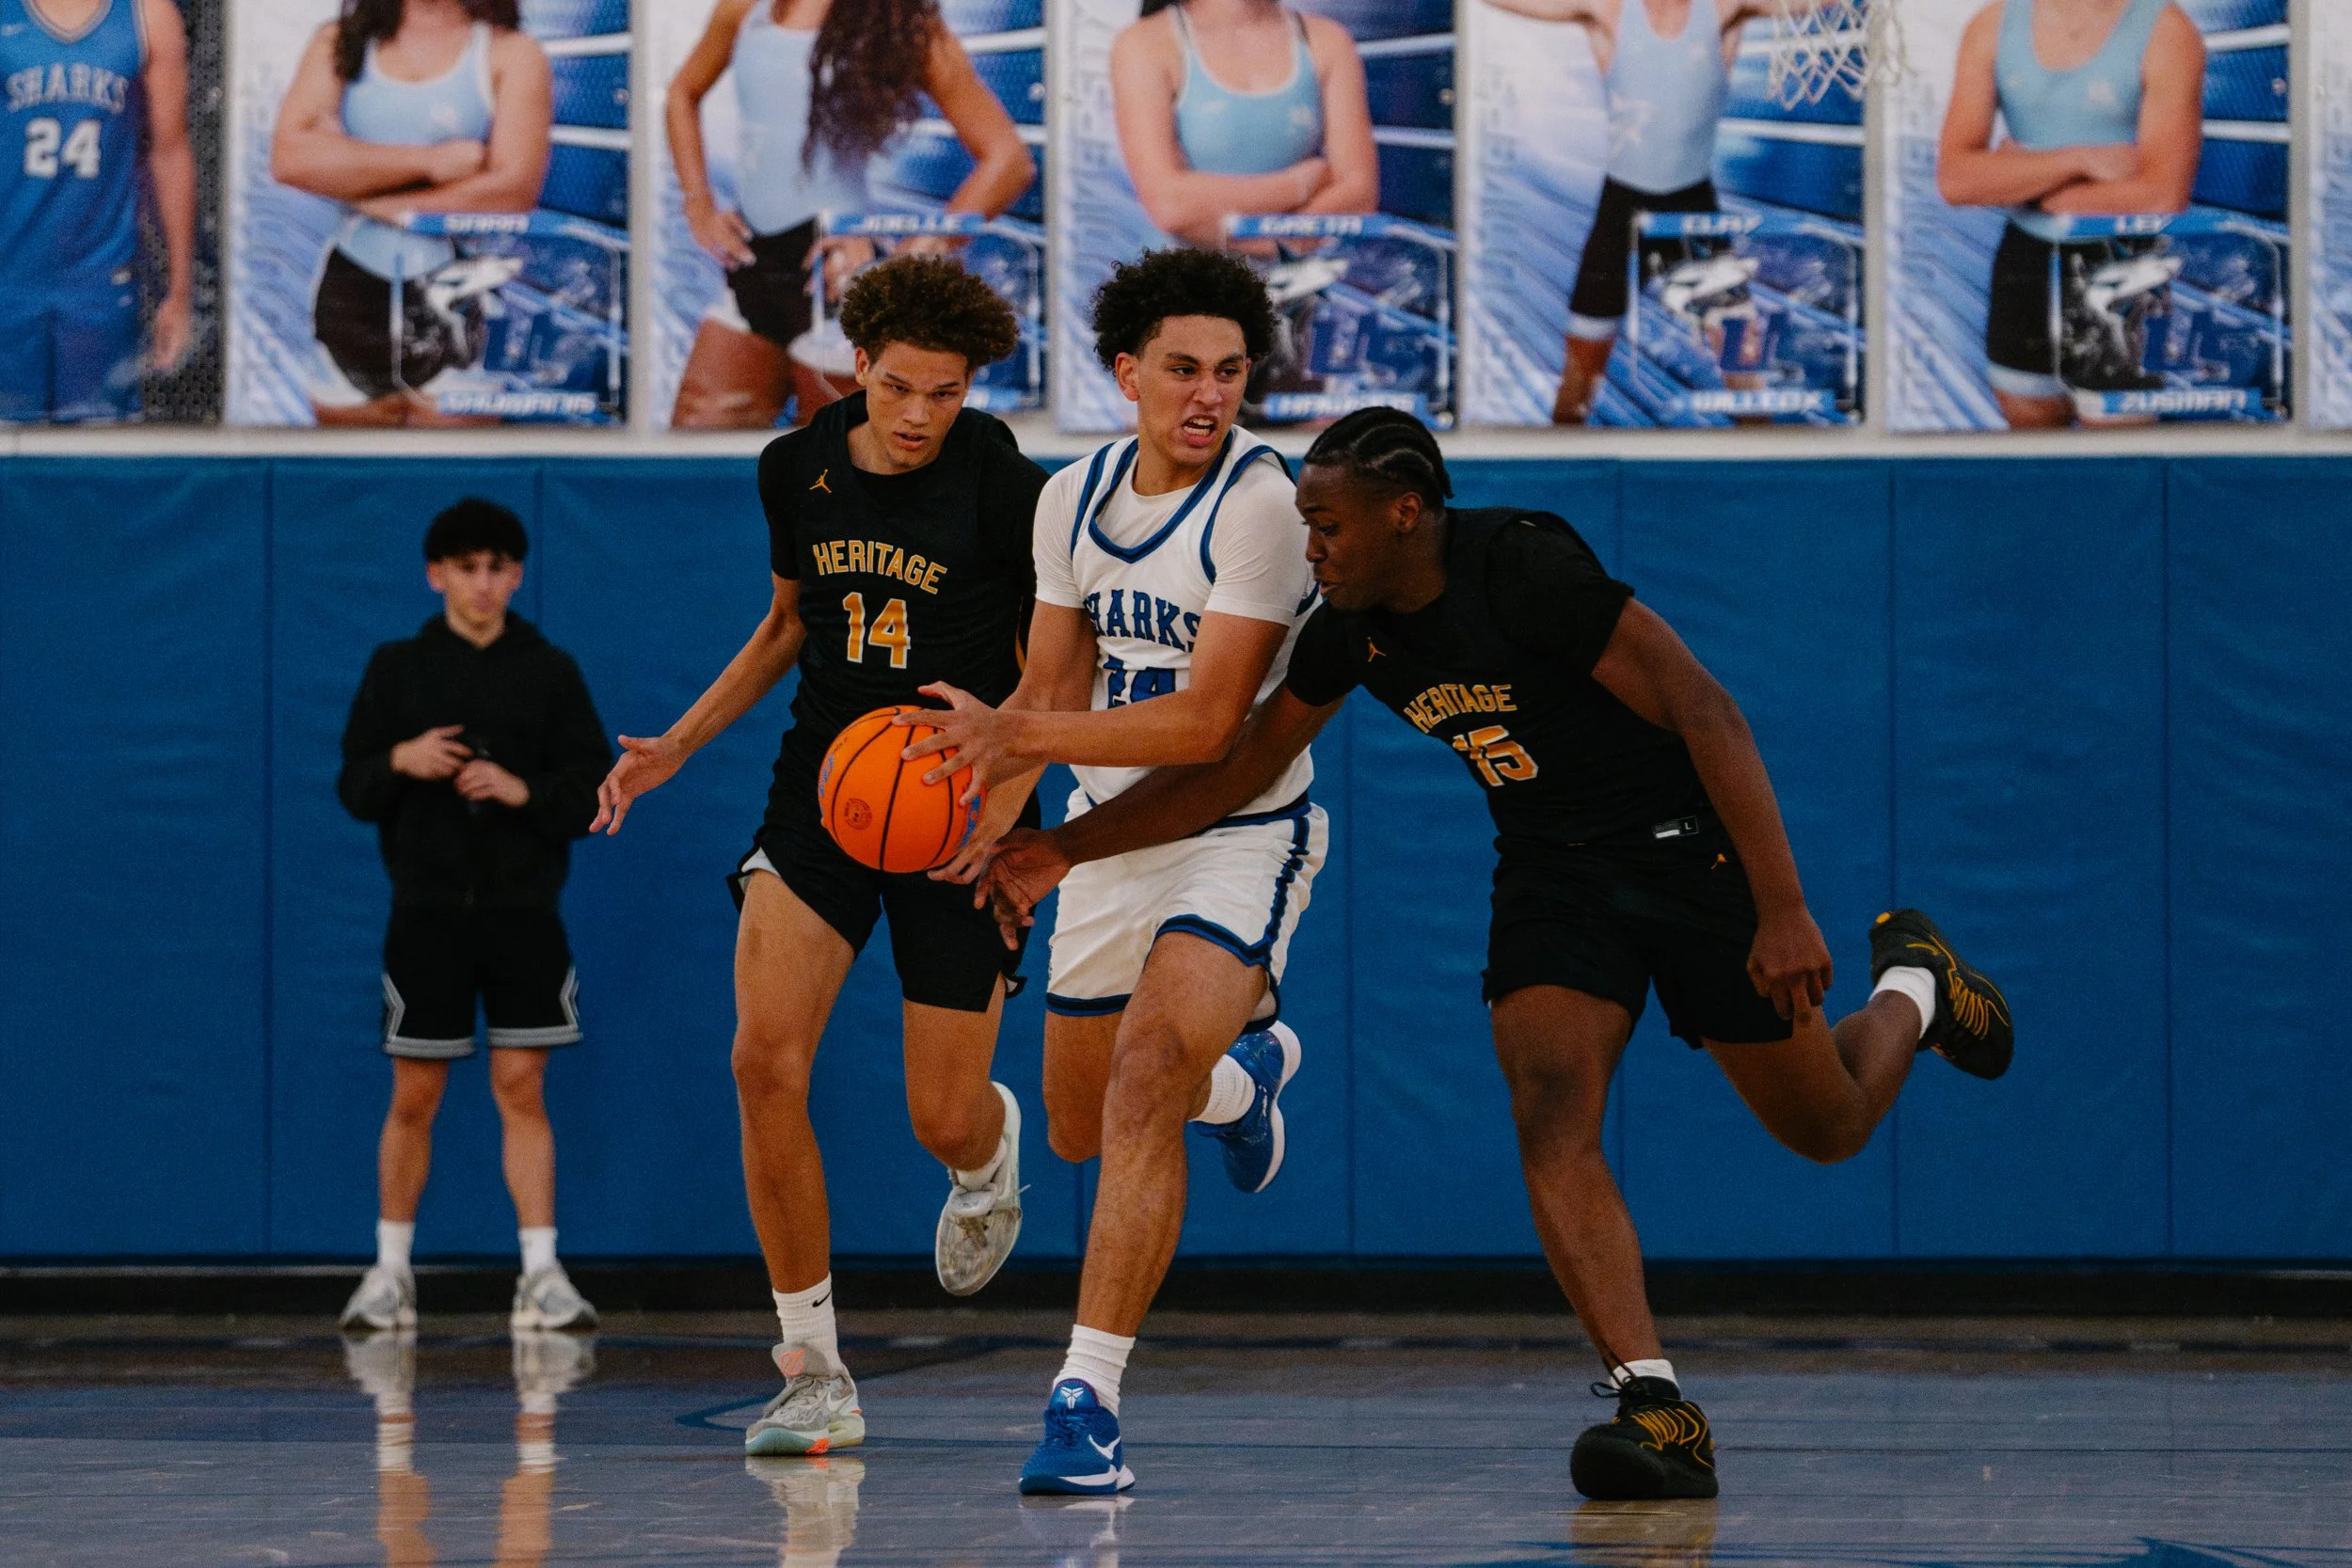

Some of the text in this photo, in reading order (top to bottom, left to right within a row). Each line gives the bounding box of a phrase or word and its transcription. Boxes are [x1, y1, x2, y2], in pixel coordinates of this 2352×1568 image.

[6, 63, 130, 115] SHARKS
[24, 118, 102, 179] 24
[813, 540, 948, 595] HERITAGE
[843, 592, 911, 670] 14
[1403, 684, 1518, 735] HERITAGE
[1452, 724, 1539, 787] 15
